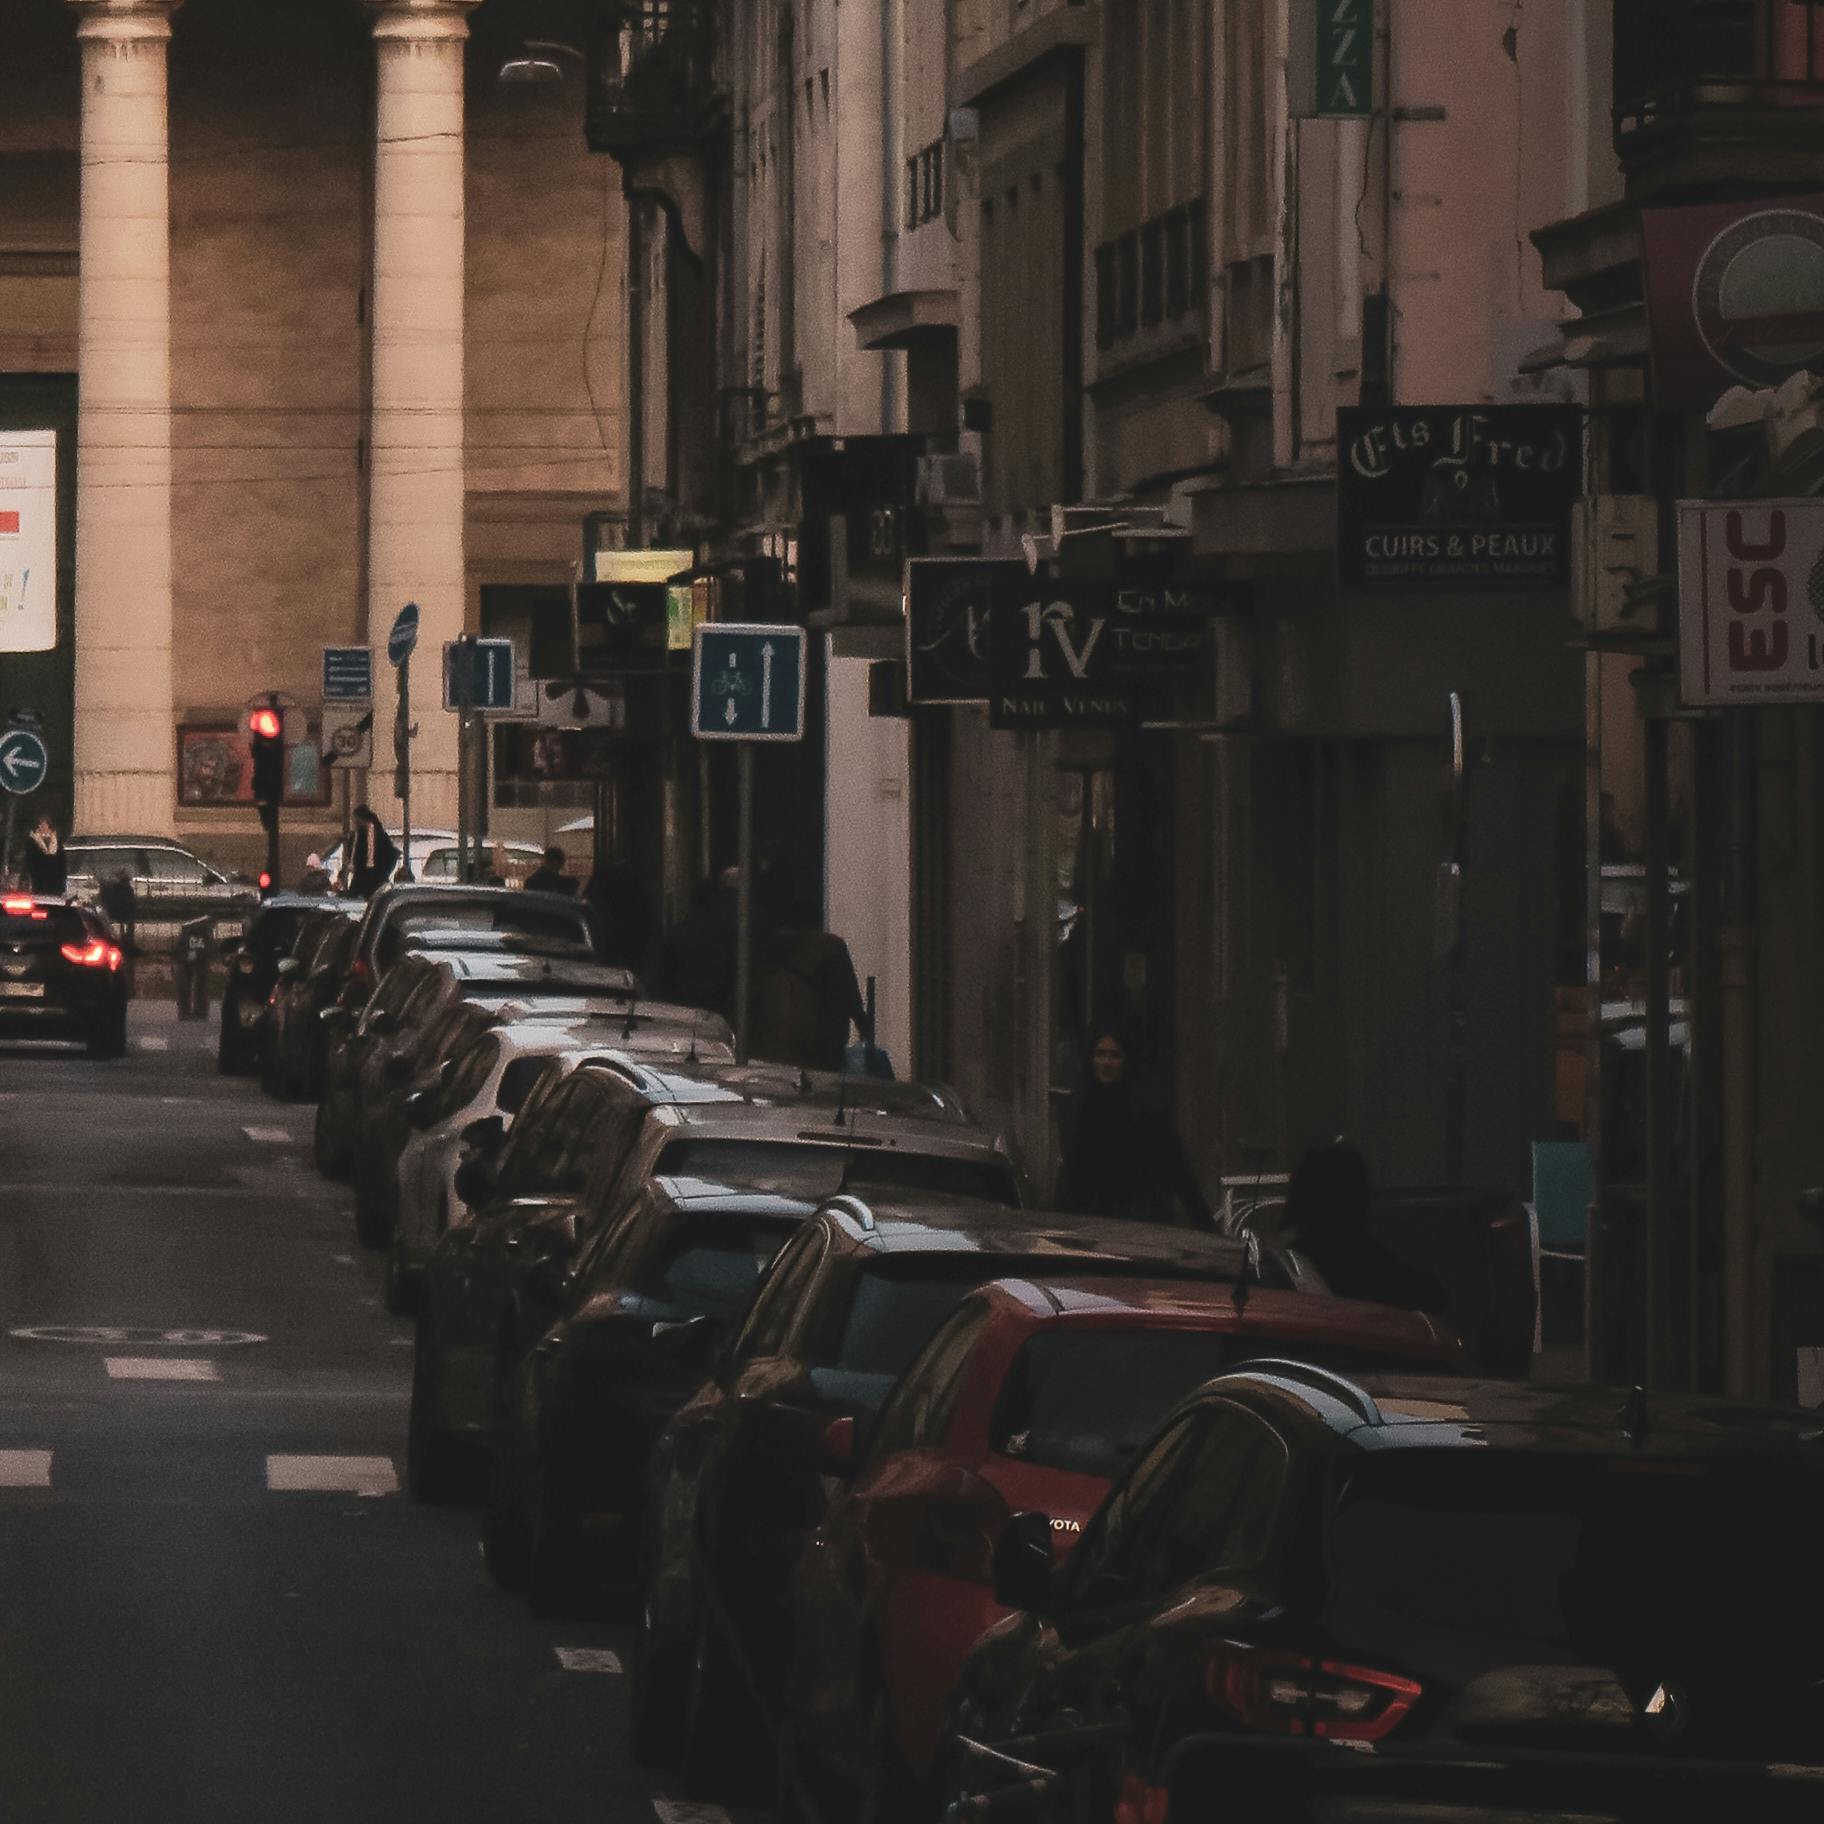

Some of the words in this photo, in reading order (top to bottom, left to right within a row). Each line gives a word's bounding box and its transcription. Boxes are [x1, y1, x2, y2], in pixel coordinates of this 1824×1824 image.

[1364, 534, 1440, 558] CUIRS
[1447, 534, 1464, 557] &
[1471, 534, 1554, 557] PEAUX
[1726, 509, 1788, 672] ESC
